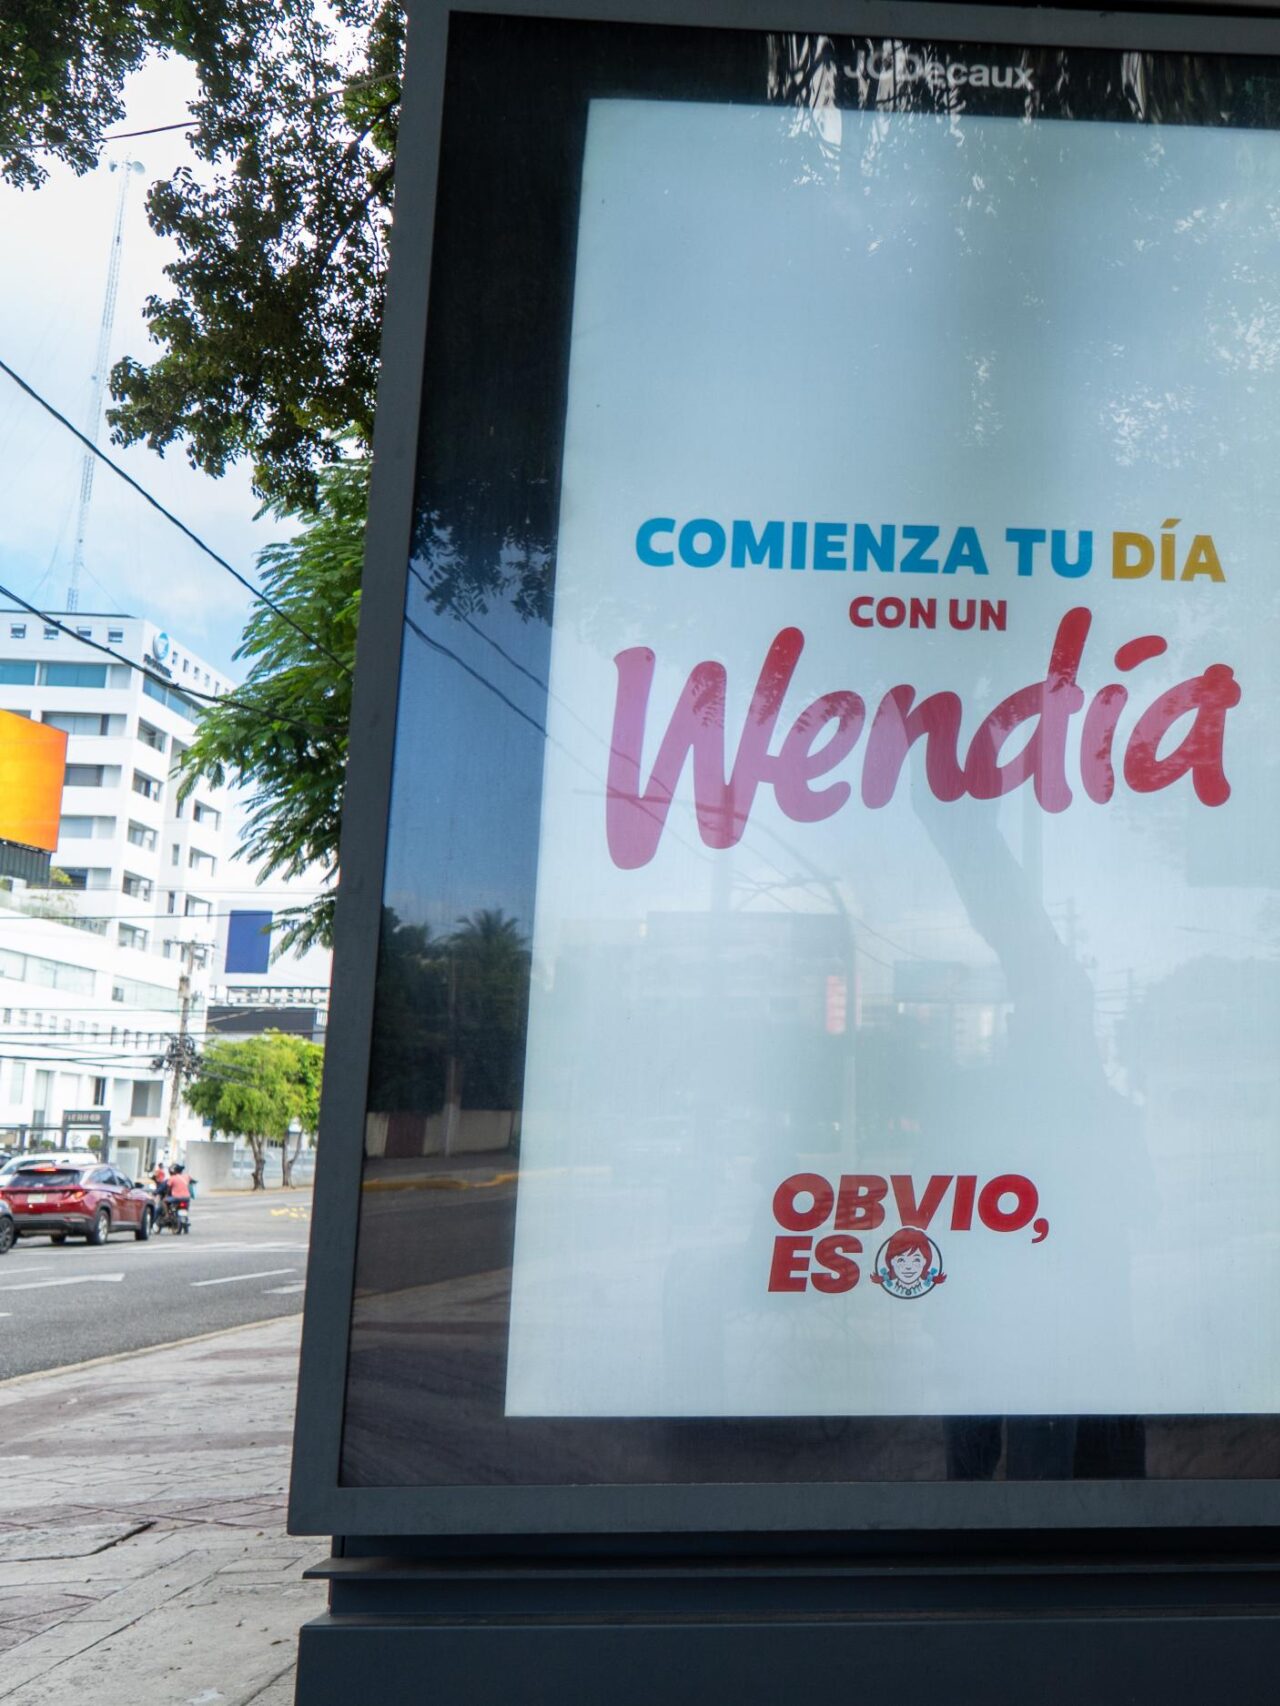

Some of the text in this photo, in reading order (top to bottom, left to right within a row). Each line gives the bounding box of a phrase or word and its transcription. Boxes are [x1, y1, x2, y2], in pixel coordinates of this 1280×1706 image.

[635, 517, 1226, 582] COMIENZA TU DÍA
[849, 596, 1007, 631] CON UN
[606, 606, 1242, 870] Wendía
[772, 1172, 1050, 1244] OBVIO,
[767, 1234, 863, 1294] ES
